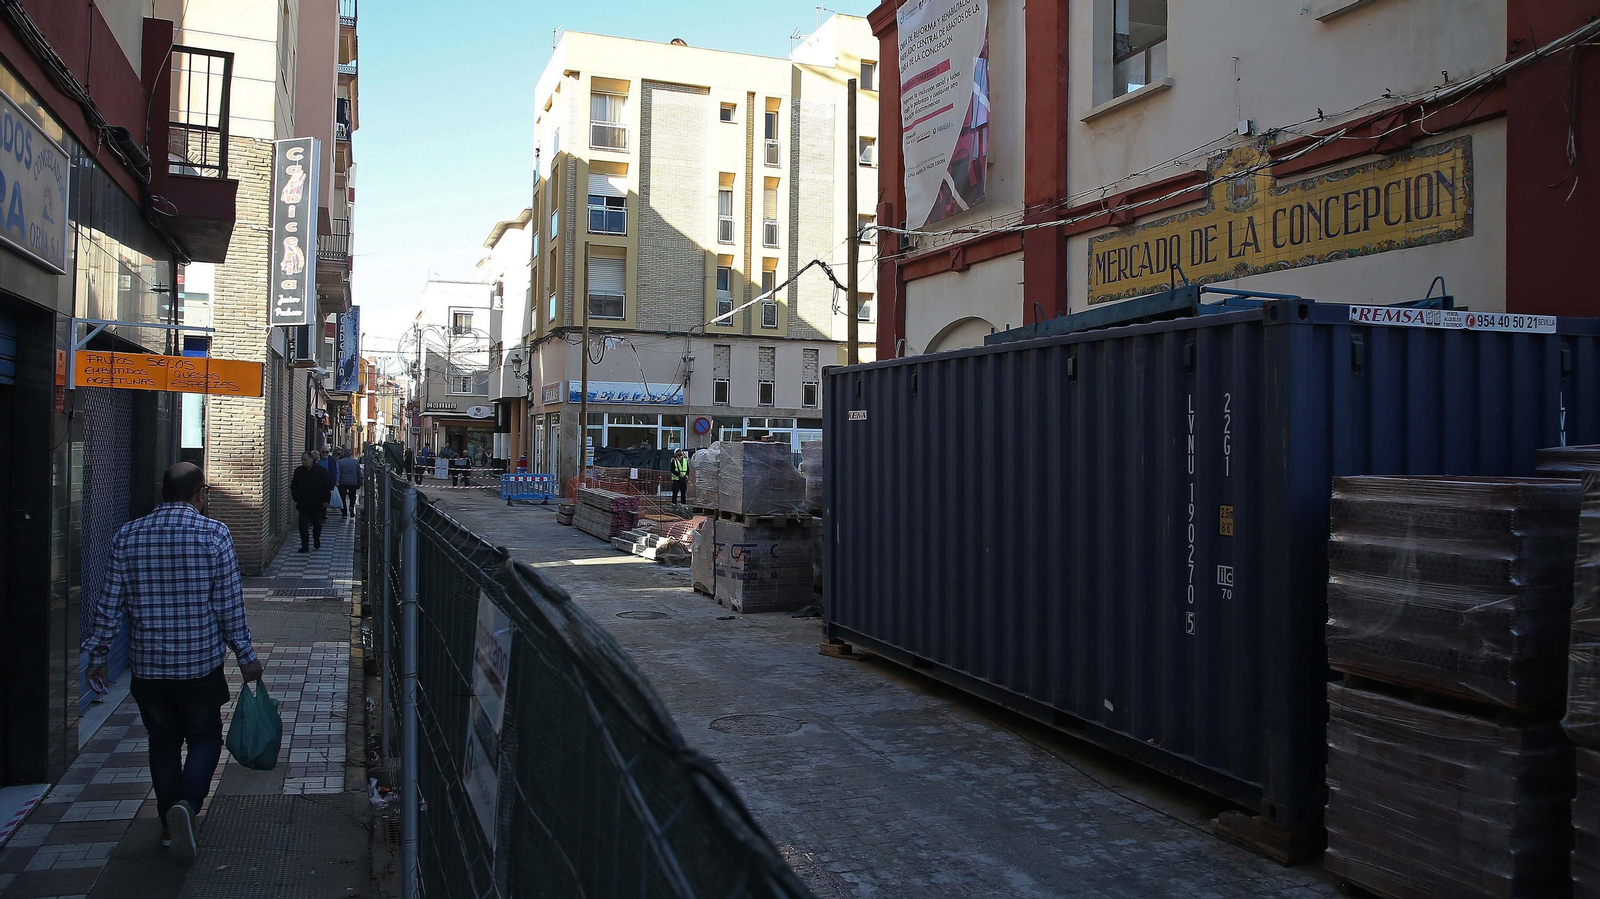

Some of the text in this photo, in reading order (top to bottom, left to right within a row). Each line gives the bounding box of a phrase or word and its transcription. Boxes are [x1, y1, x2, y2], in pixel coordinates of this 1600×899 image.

[913, 22, 937, 39] REFORMA
[917, 34, 939, 50] CENTRAL
[939, 28, 945, 37] DE
[945, 14, 965, 33] ABASTOS
[965, 9, 972, 19] DE
[972, 3, 981, 14] LA
[914, 54, 921, 63] LA
[1095, 234, 1181, 286] MERCADO
[1190, 224, 1217, 267] DE
[1227, 216, 1261, 259] LA
[1358, 307, 1425, 324] REMSA
[1477, 315, 1538, 329] 954 40 50 21
[1538, 319, 1555, 327] SEVILLA
[86, 354, 194, 370] FRUTOS SECOS
[84, 367, 220, 380] EMBUTIDOS QUESOS
[86, 377, 240, 392] ACEITUNAS ESPECIES
[1187, 394, 1195, 475] LVNU
[1223, 392, 1231, 477] 22G1
[1187, 482, 1195, 604] 190270
[1221, 588, 1233, 600] 70
[1187, 612, 1195, 633] 5
